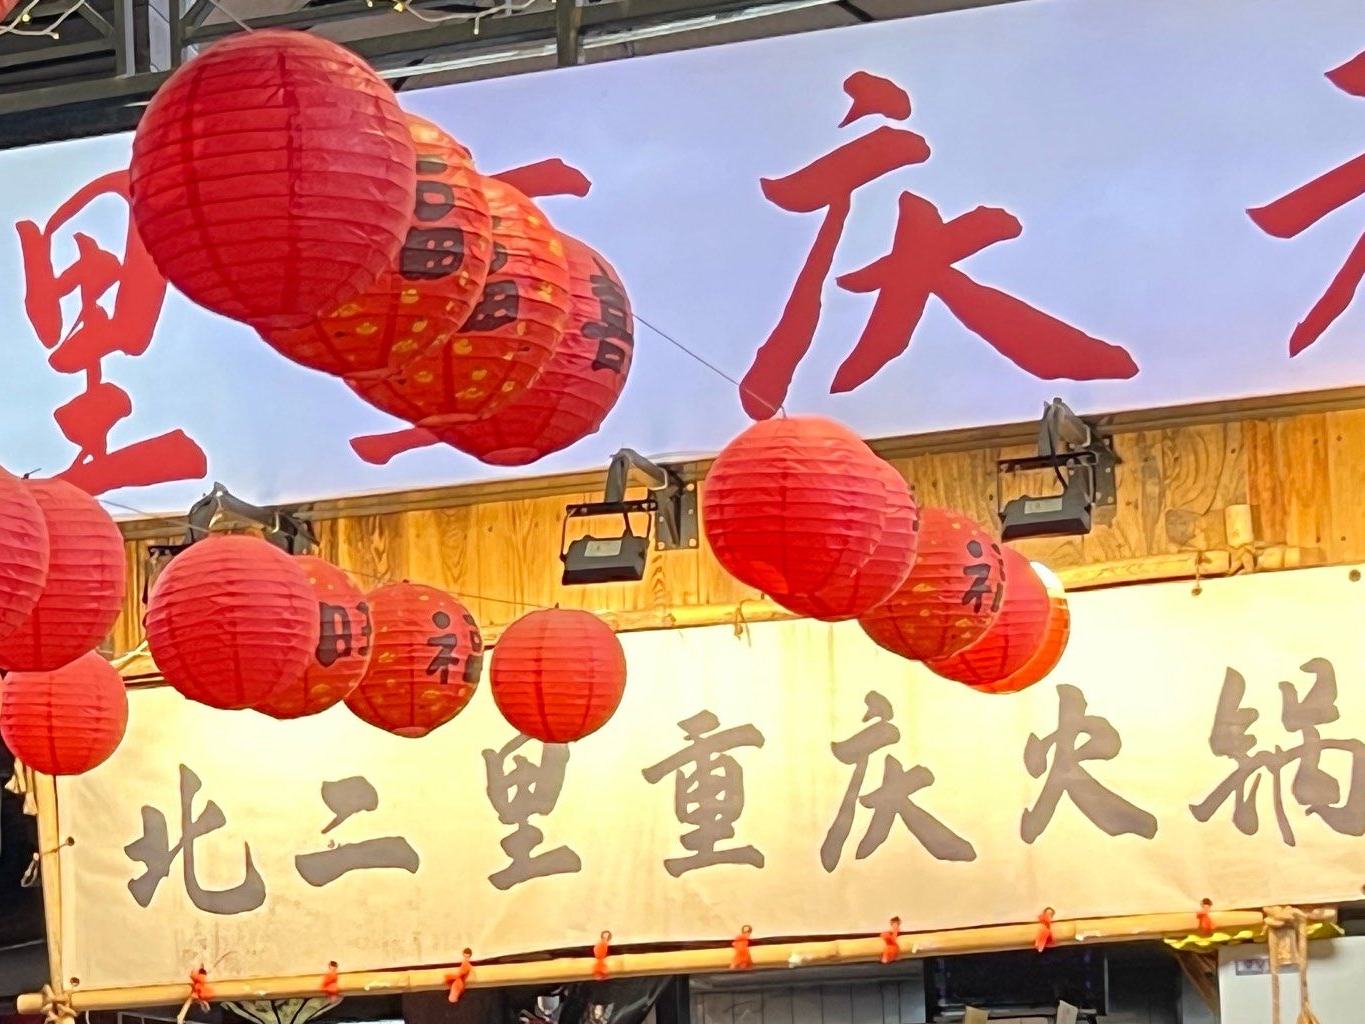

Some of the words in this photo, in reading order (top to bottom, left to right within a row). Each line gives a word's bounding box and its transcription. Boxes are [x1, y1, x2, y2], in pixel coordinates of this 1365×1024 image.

[125, 657, 1365, 916] 北二里重庆火锅
